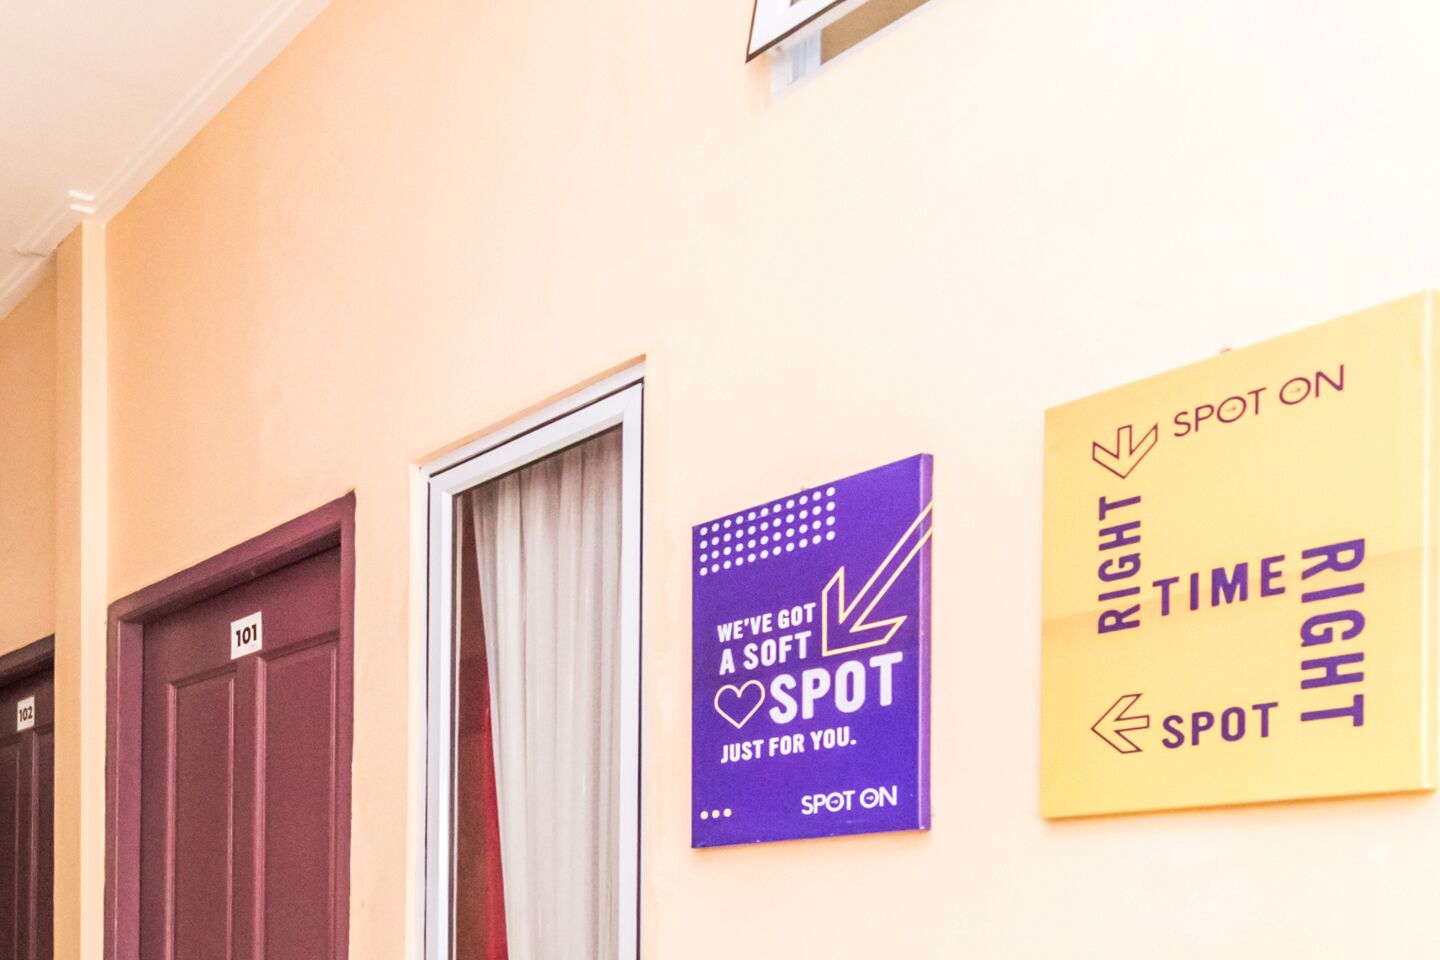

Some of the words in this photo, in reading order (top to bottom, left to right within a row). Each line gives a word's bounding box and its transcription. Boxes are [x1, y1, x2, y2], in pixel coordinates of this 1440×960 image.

[1173, 387, 1267, 437] SPOT
[1278, 364, 1345, 405] ON
[1097, 495, 1141, 634] RIGHT
[1152, 554, 1286, 616] TIME
[236, 624, 257, 647] 101
[717, 613, 773, 643] WE'VE
[777, 602, 816, 629] GOT
[1300, 538, 1365, 727] RIGHT
[719, 648, 736, 676] A
[743, 631, 813, 670] SOFT
[768, 651, 903, 725] SPOT
[19, 706, 32, 722] 102
[1161, 702, 1279, 749] SPOT
[720, 739, 764, 764] JUST
[768, 731, 805, 757] FOR
[810, 726, 857, 750] YOU.
[801, 790, 856, 815] SPOT
[859, 785, 897, 809] ON
